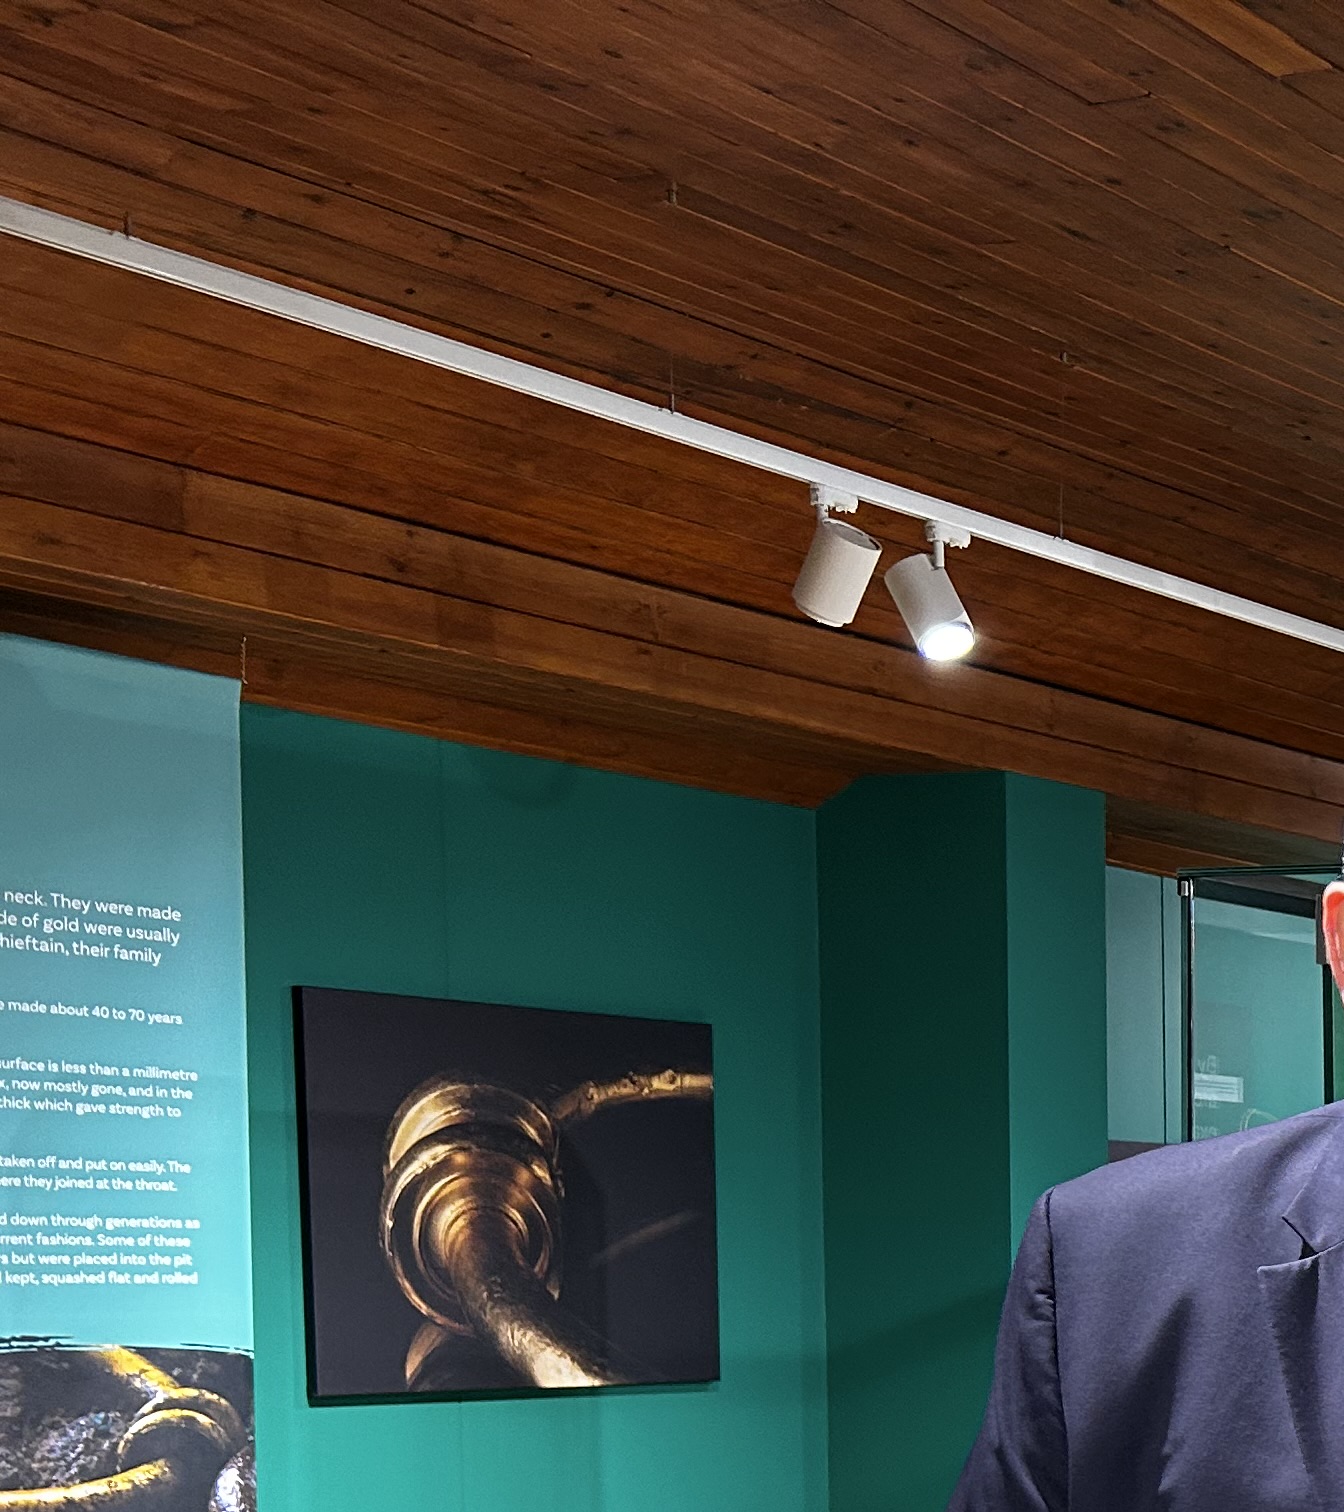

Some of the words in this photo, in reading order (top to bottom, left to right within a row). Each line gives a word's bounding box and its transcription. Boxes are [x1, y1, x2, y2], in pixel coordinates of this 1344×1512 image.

[5, 890, 47, 907] neck.
[50, 892, 91, 914] They
[95, 900, 134, 916] were
[137, 906, 182, 922] made
[22, 912, 39, 928] of
[43, 916, 79, 934] gold
[84, 922, 123, 937] were
[126, 926, 180, 947] usually
[72, 940, 109, 958] their
[114, 943, 161, 967] family
[8, 1000, 47, 1014] made
[50, 1002, 89, 1017] about
[92, 1005, 109, 1020] 40
[112, 1008, 126, 1021] to
[128, 1008, 145, 1021] 70
[147, 1012, 183, 1025] years
[47, 1059, 59, 1073] is
[62, 1060, 87, 1075] less
[89, 1061, 119, 1077] than
[122, 1066, 131, 1077] a
[132, 1066, 199, 1081] millimetre
[12, 1079, 40, 1091] now
[43, 1080, 89, 1097] mostly
[91, 1084, 127, 1097] gone,
[128, 1083, 153, 1097] and
[155, 1085, 168, 1099] in
[170, 1086, 193, 1100] the
[34, 1098, 73, 1112] which
[75, 1103, 106, 1116] gave
[109, 1102, 164, 1119] strength
[166, 1104, 181, 1118] to
[37, 1155, 57, 1169] off
[58, 1157, 82, 1170] and
[85, 1158, 108, 1172] put
[109, 1161, 126, 1172] on
[128, 1160, 166, 1175] easily.
[167, 1160, 191, 1174] The
[24, 1174, 53, 1190] they
[54, 1176, 93, 1191] joined
[95, 1178, 110, 1190] at
[111, 1177, 133, 1191] the
[135, 1178, 178, 1192] throat.
[10, 1212, 48, 1226] down
[50, 1213, 103, 1230] through
[105, 1216, 182, 1231] generations
[184, 1219, 201, 1230] as
[36, 1232, 95, 1246] fashions.
[97, 1233, 135, 1247] Some
[137, 1234, 152, 1247] of
[153, 1235, 191, 1248] these
[11, 1251, 36, 1264] but
[37, 1254, 71, 1265] were
[73, 1252, 117, 1267] placed
[119, 1253, 146, 1265] into
[149, 1253, 171, 1265] the
[173, 1254, 193, 1268] pit
[5, 1271, 40, 1286] kept,
[41, 1271, 105, 1286] squashed
[107, 1271, 131, 1284] flat
[133, 1272, 159, 1285] and
[161, 1271, 199, 1285] rolled
